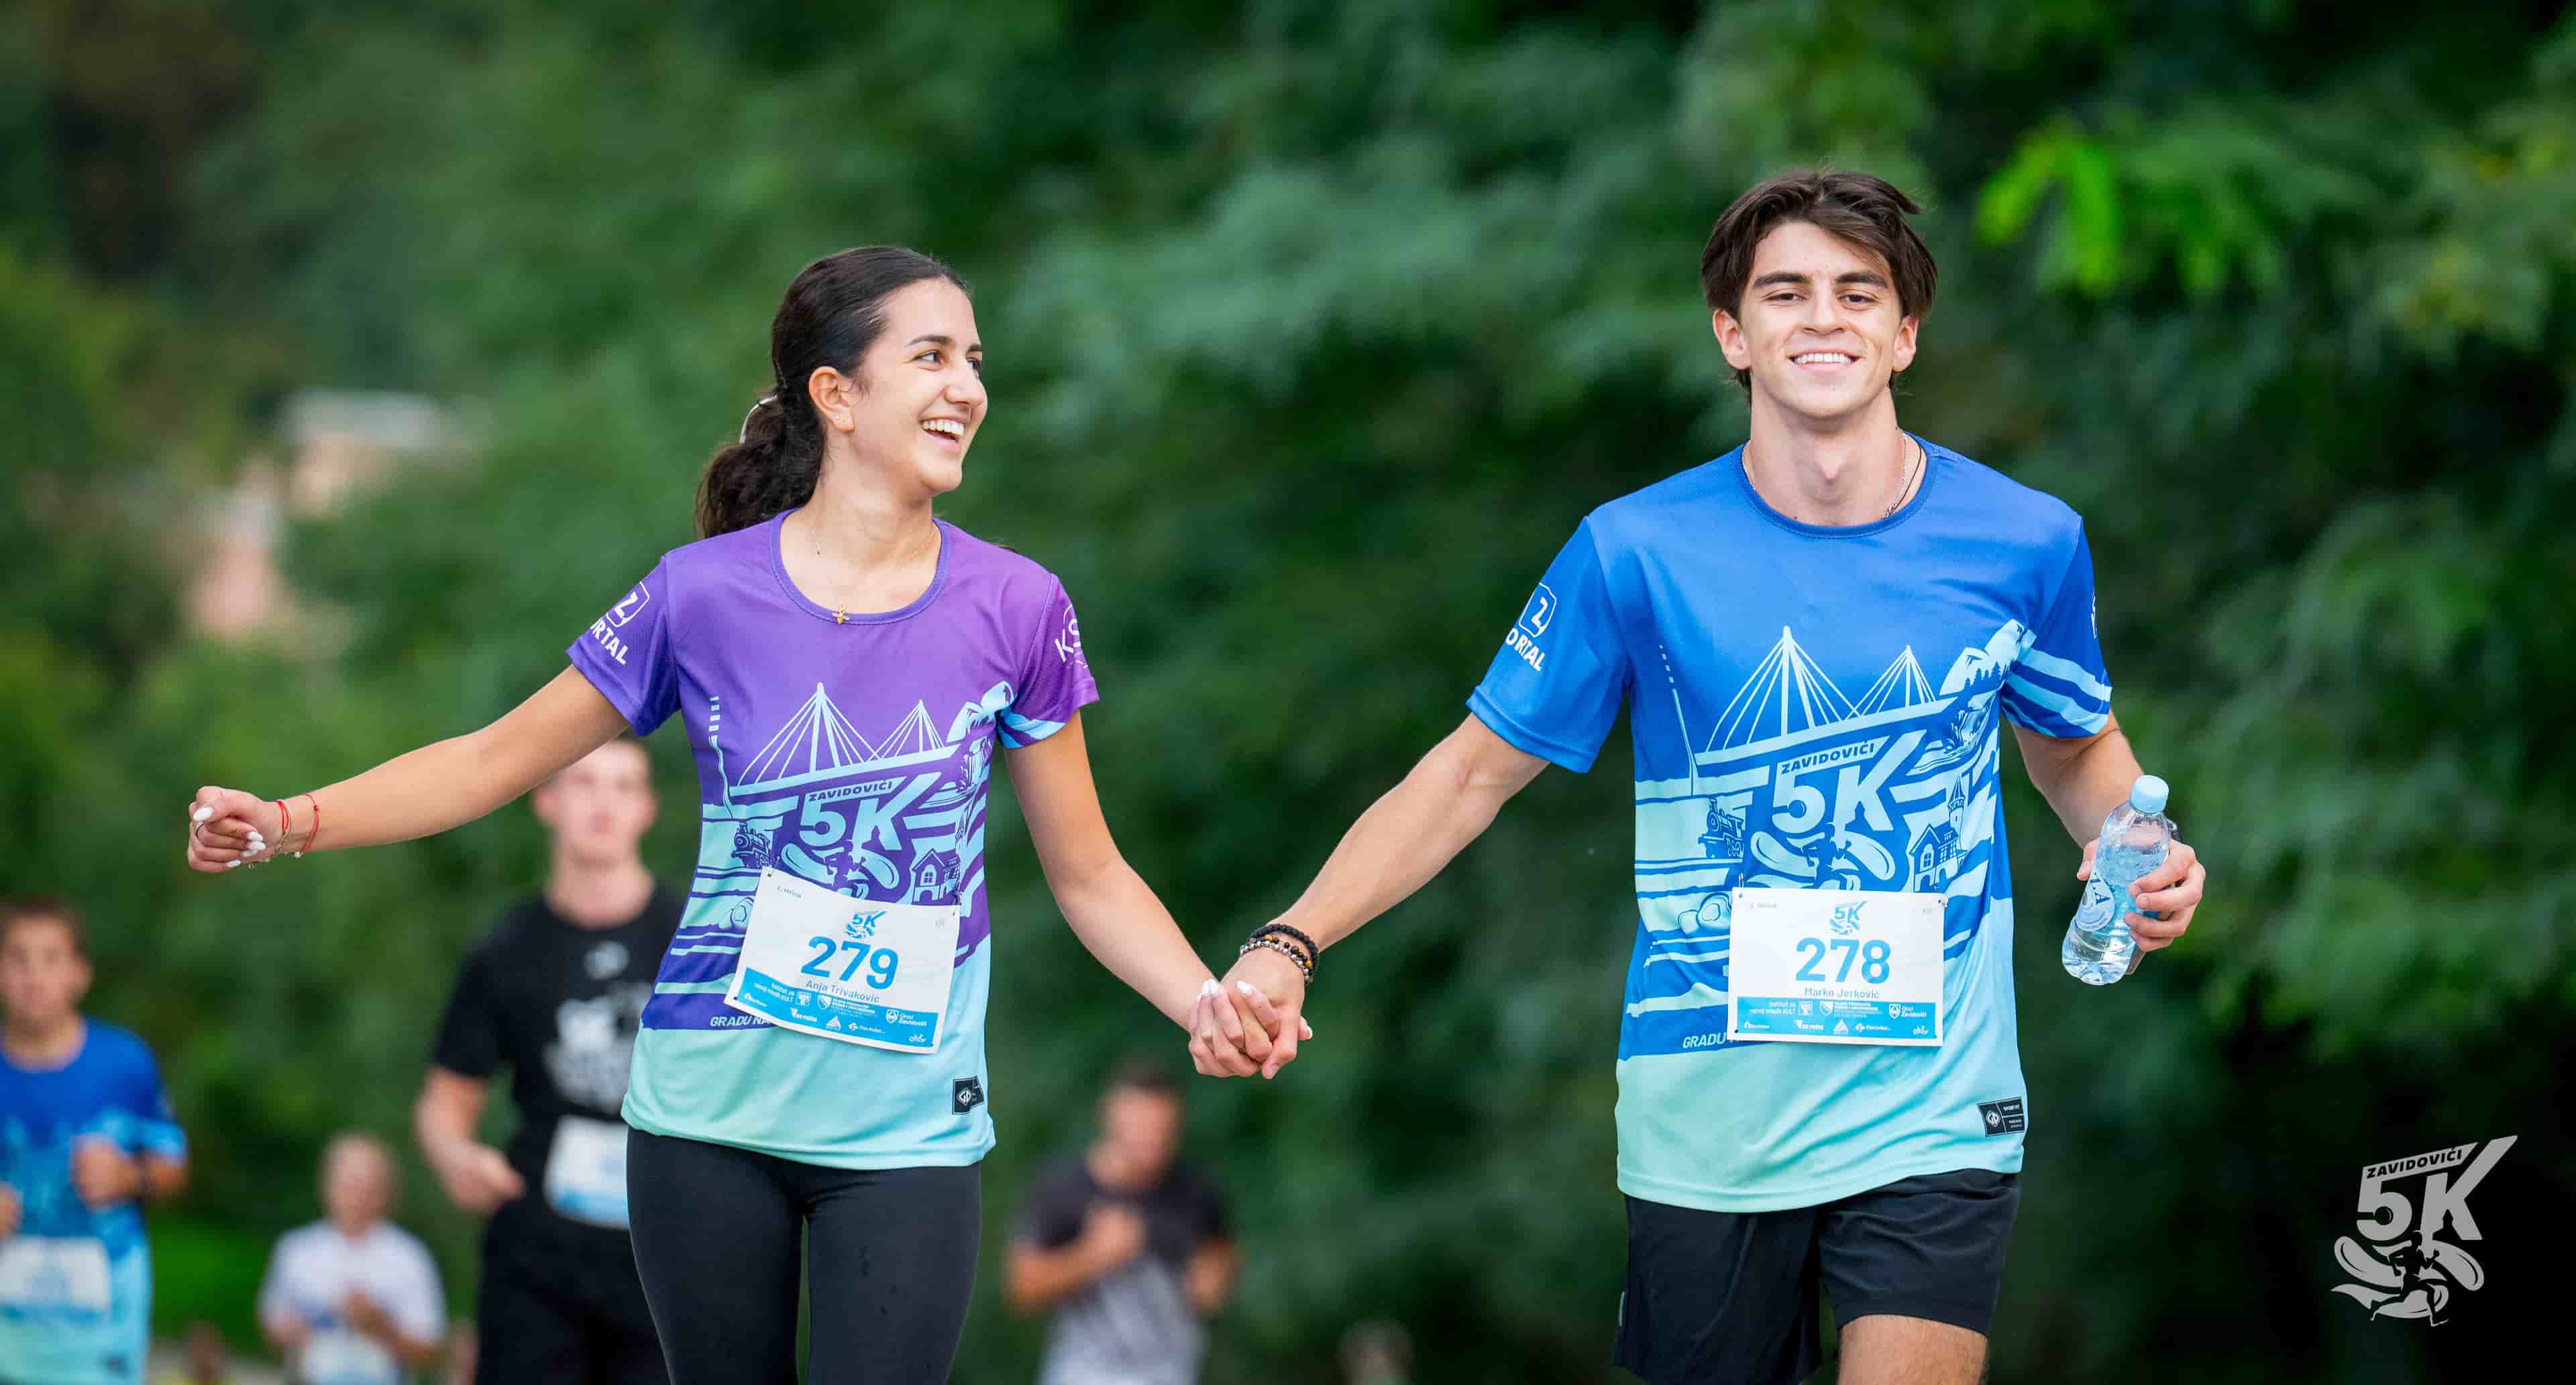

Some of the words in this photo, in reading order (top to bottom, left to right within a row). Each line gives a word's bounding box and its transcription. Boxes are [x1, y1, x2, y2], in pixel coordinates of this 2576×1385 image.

[1782, 740, 1875, 774] ZAVIDOVIĆI
[809, 780, 892, 802] ZAVIDOVIĆI
[1772, 729, 1927, 834] 5K
[799, 772, 941, 851] 5K
[851, 910, 887, 929] 5K
[1833, 901, 1868, 921] 5K
[800, 936, 899, 990] 279
[1795, 937, 1891, 984] 278
[806, 980, 828, 992] Anja
[1805, 988, 1835, 997] Marko
[710, 1015, 752, 1027] GRADU
[1682, 1032, 1727, 1048] GRADU
